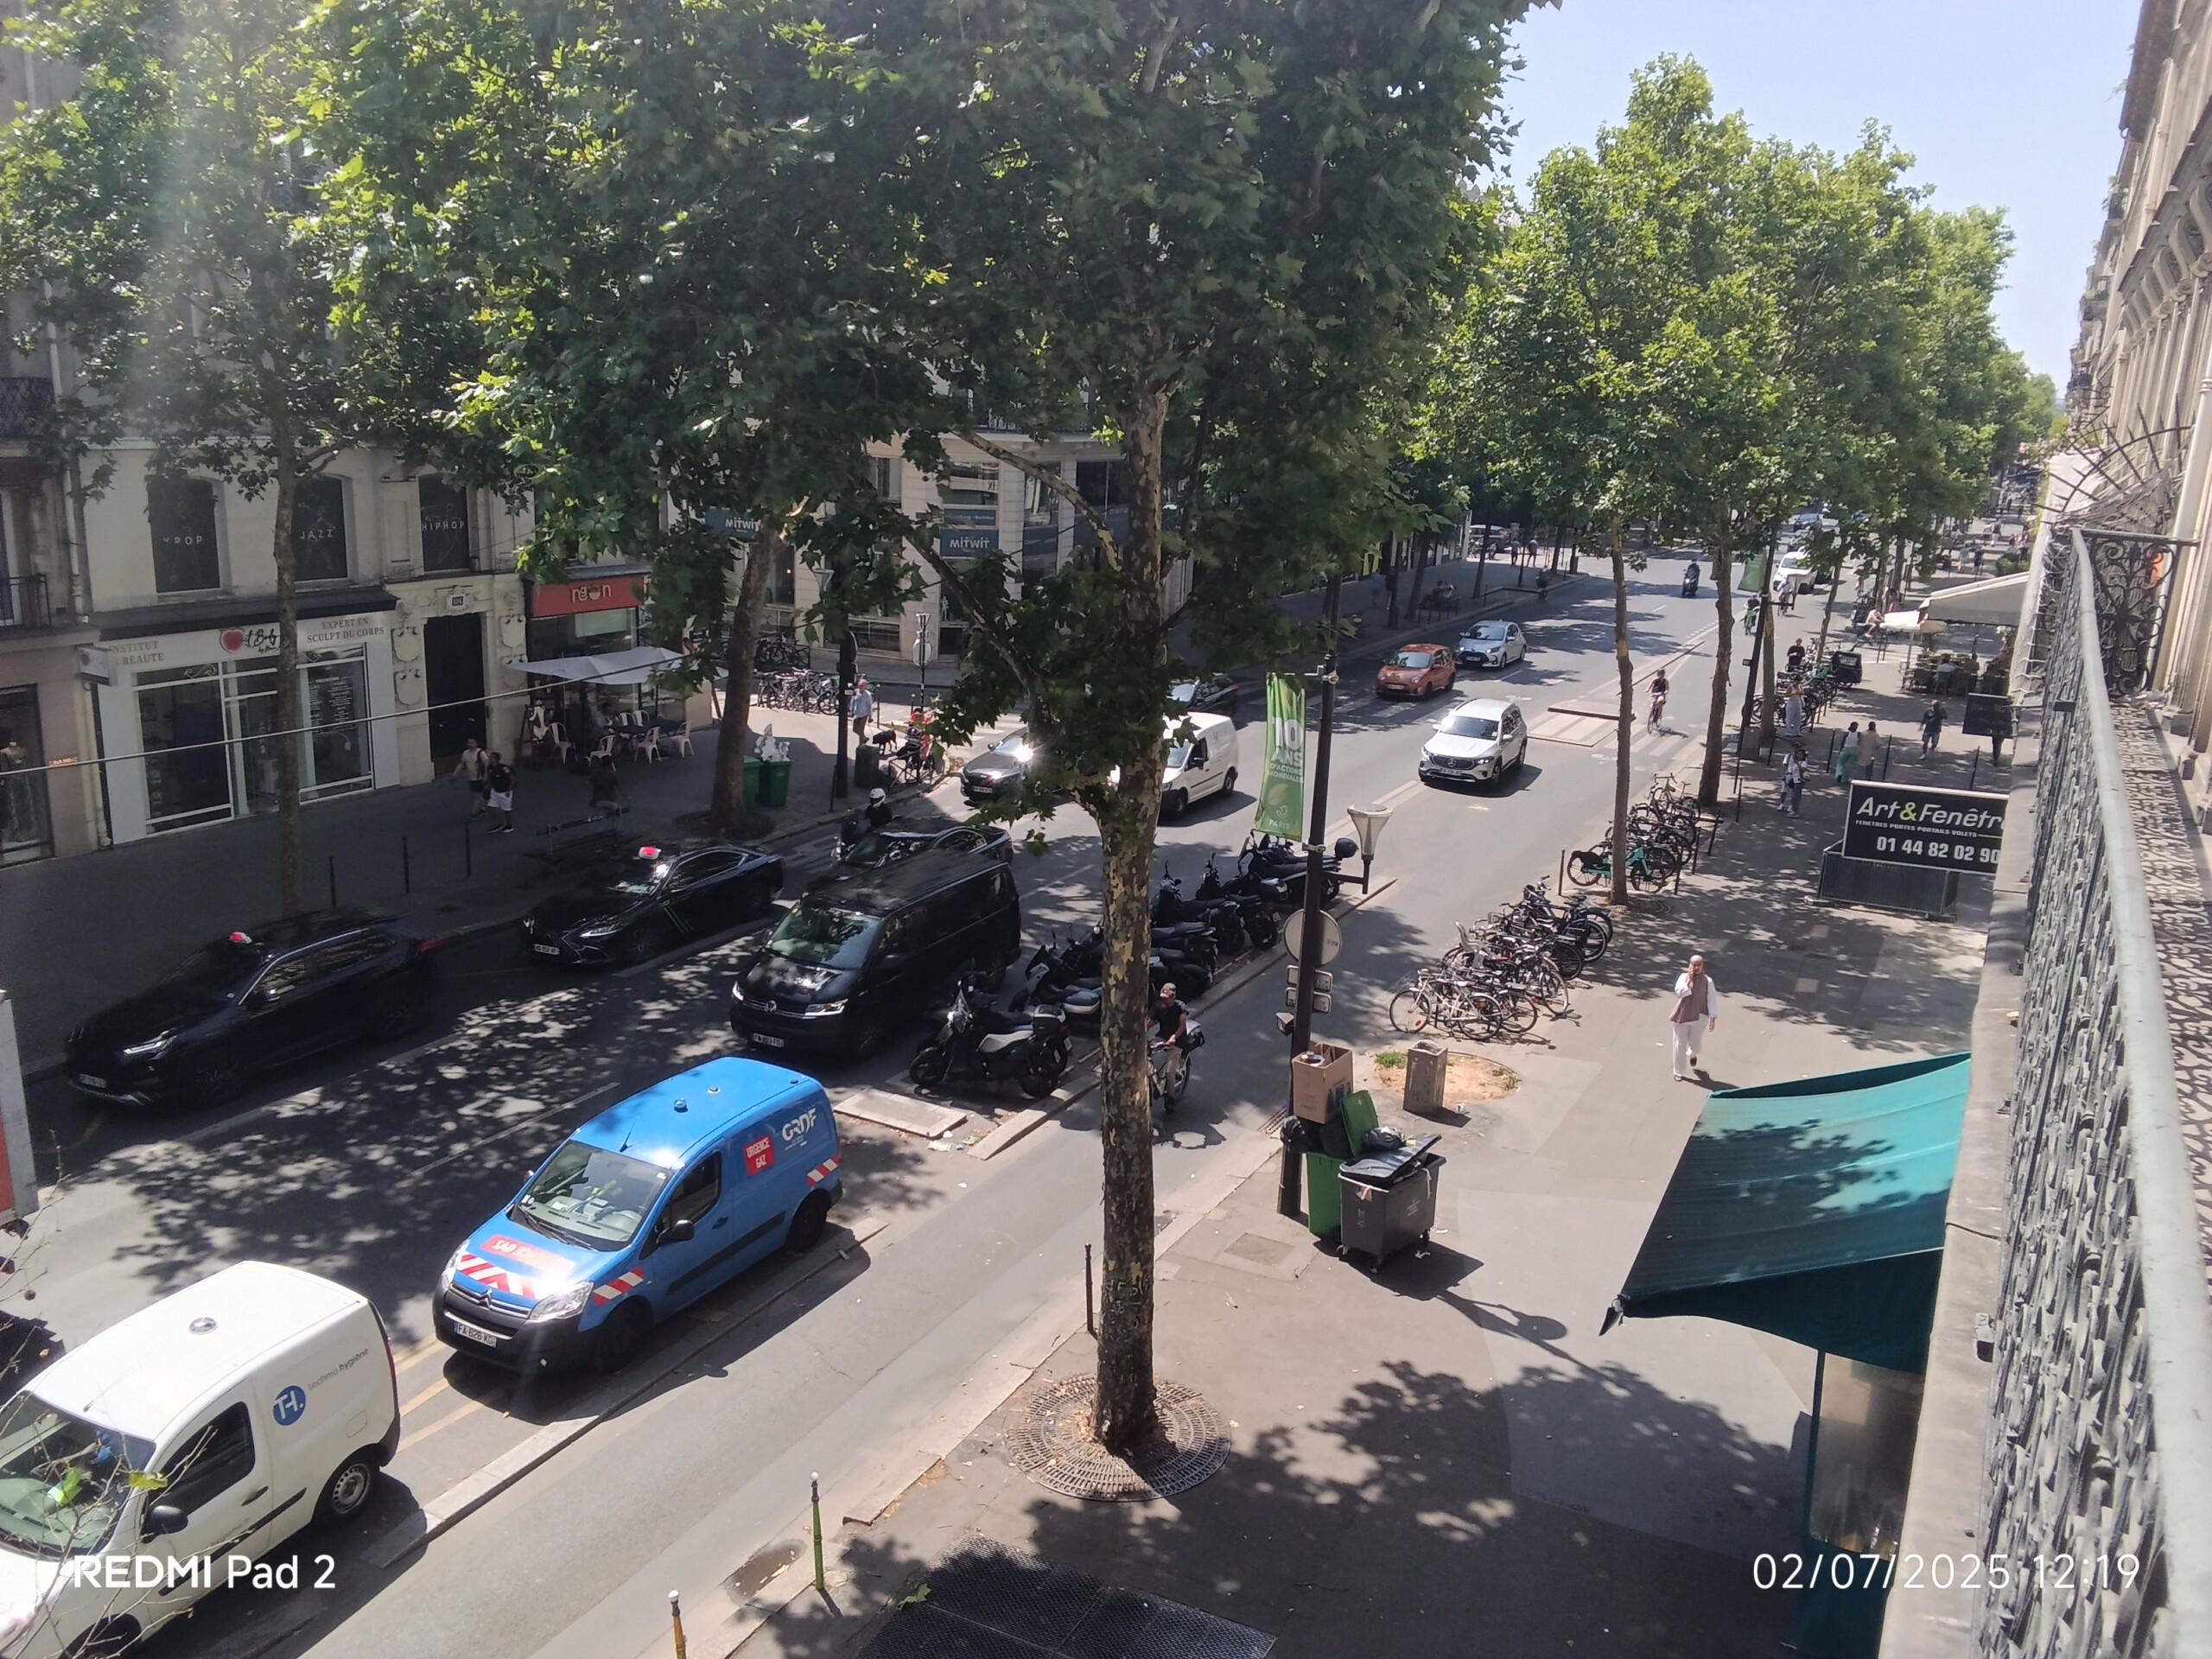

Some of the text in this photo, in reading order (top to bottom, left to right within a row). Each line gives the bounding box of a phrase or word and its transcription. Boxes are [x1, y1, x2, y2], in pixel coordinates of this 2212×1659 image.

[422, 520, 465, 531] HIPHOP
[300, 529, 334, 539] JAZZ
[321, 617, 370, 630] EXPERT EN
[307, 626, 385, 643] SCULPT DU CORPS
[123, 652, 165, 665] BEAUTE
[1272, 716, 1304, 750] 10
[1271, 748, 1303, 767] ANS
[1268, 819, 1291, 830] PARIS
[1916, 826, 1950, 835] PORTAILS
[1951, 830, 1978, 838] VOLETS
[1877, 836, 2001, 864] 01 44 82 02 90
